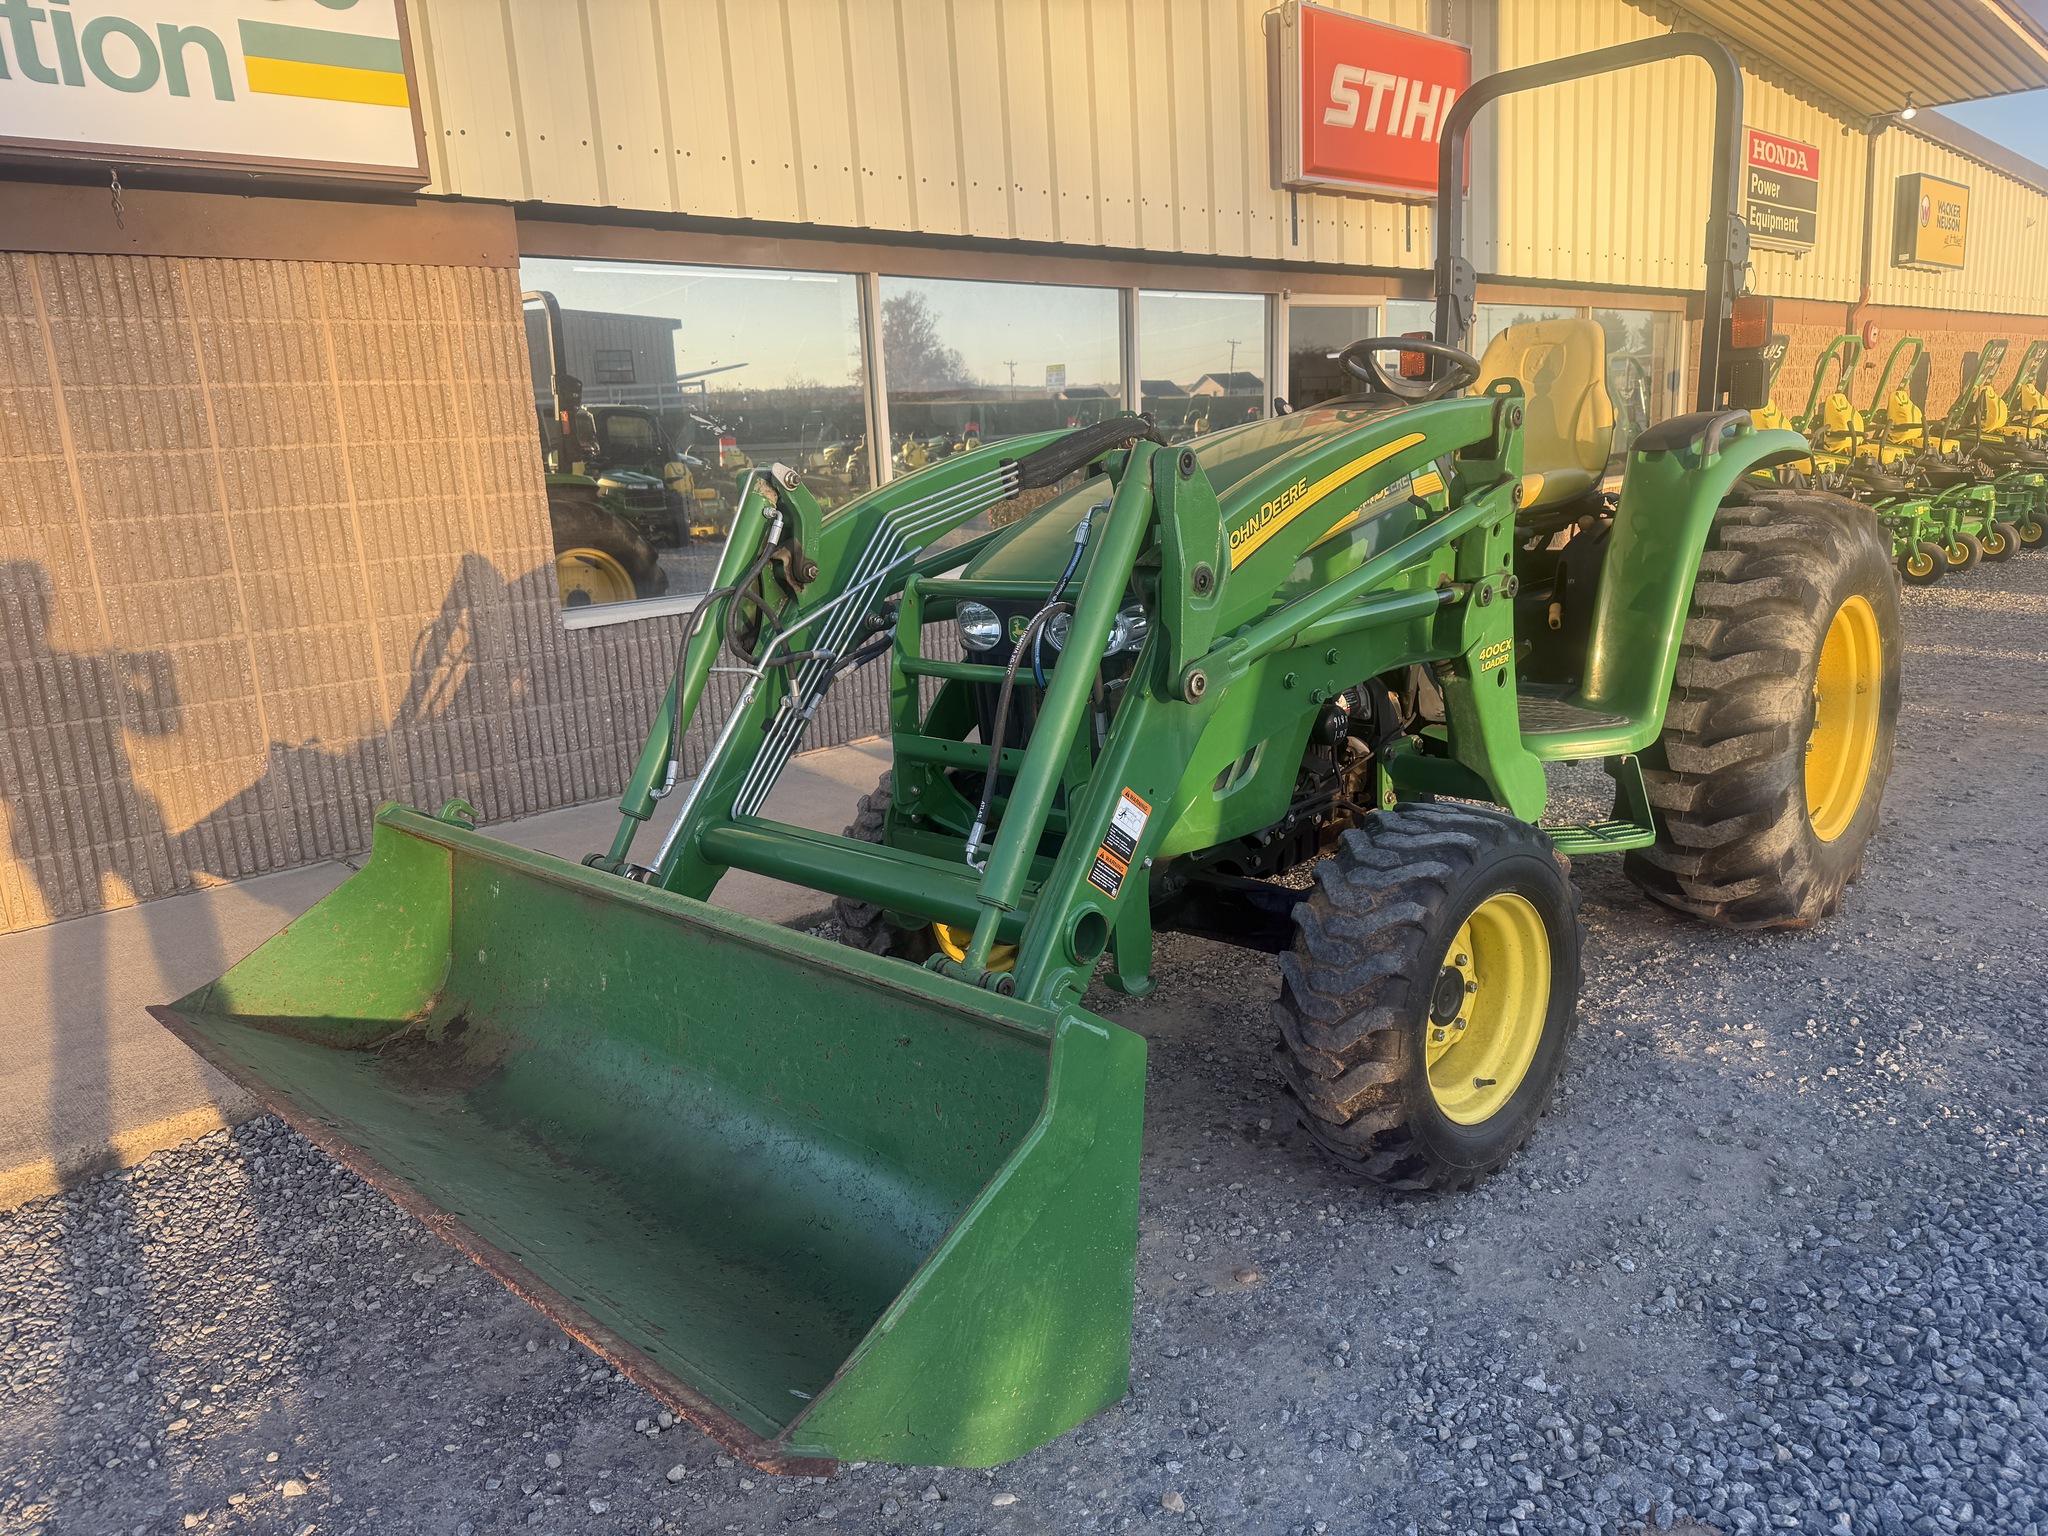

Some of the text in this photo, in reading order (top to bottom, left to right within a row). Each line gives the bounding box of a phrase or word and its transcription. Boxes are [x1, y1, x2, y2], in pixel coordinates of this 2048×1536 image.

[0, 0, 235, 101] tion
[1752, 138, 1809, 172] HONDA
[1751, 172, 1780, 198] Power
[1749, 205, 1799, 233] Equipment
[1937, 199, 1961, 219] WACKER
[1936, 214, 1961, 232] NEUSON
[1260, 476, 1308, 527] DEERE
[1479, 637, 1513, 661] 400CX
[1481, 653, 1510, 673] LOADER
[1129, 793, 1148, 812] WARNING
[1105, 855, 1124, 873] WARNING
